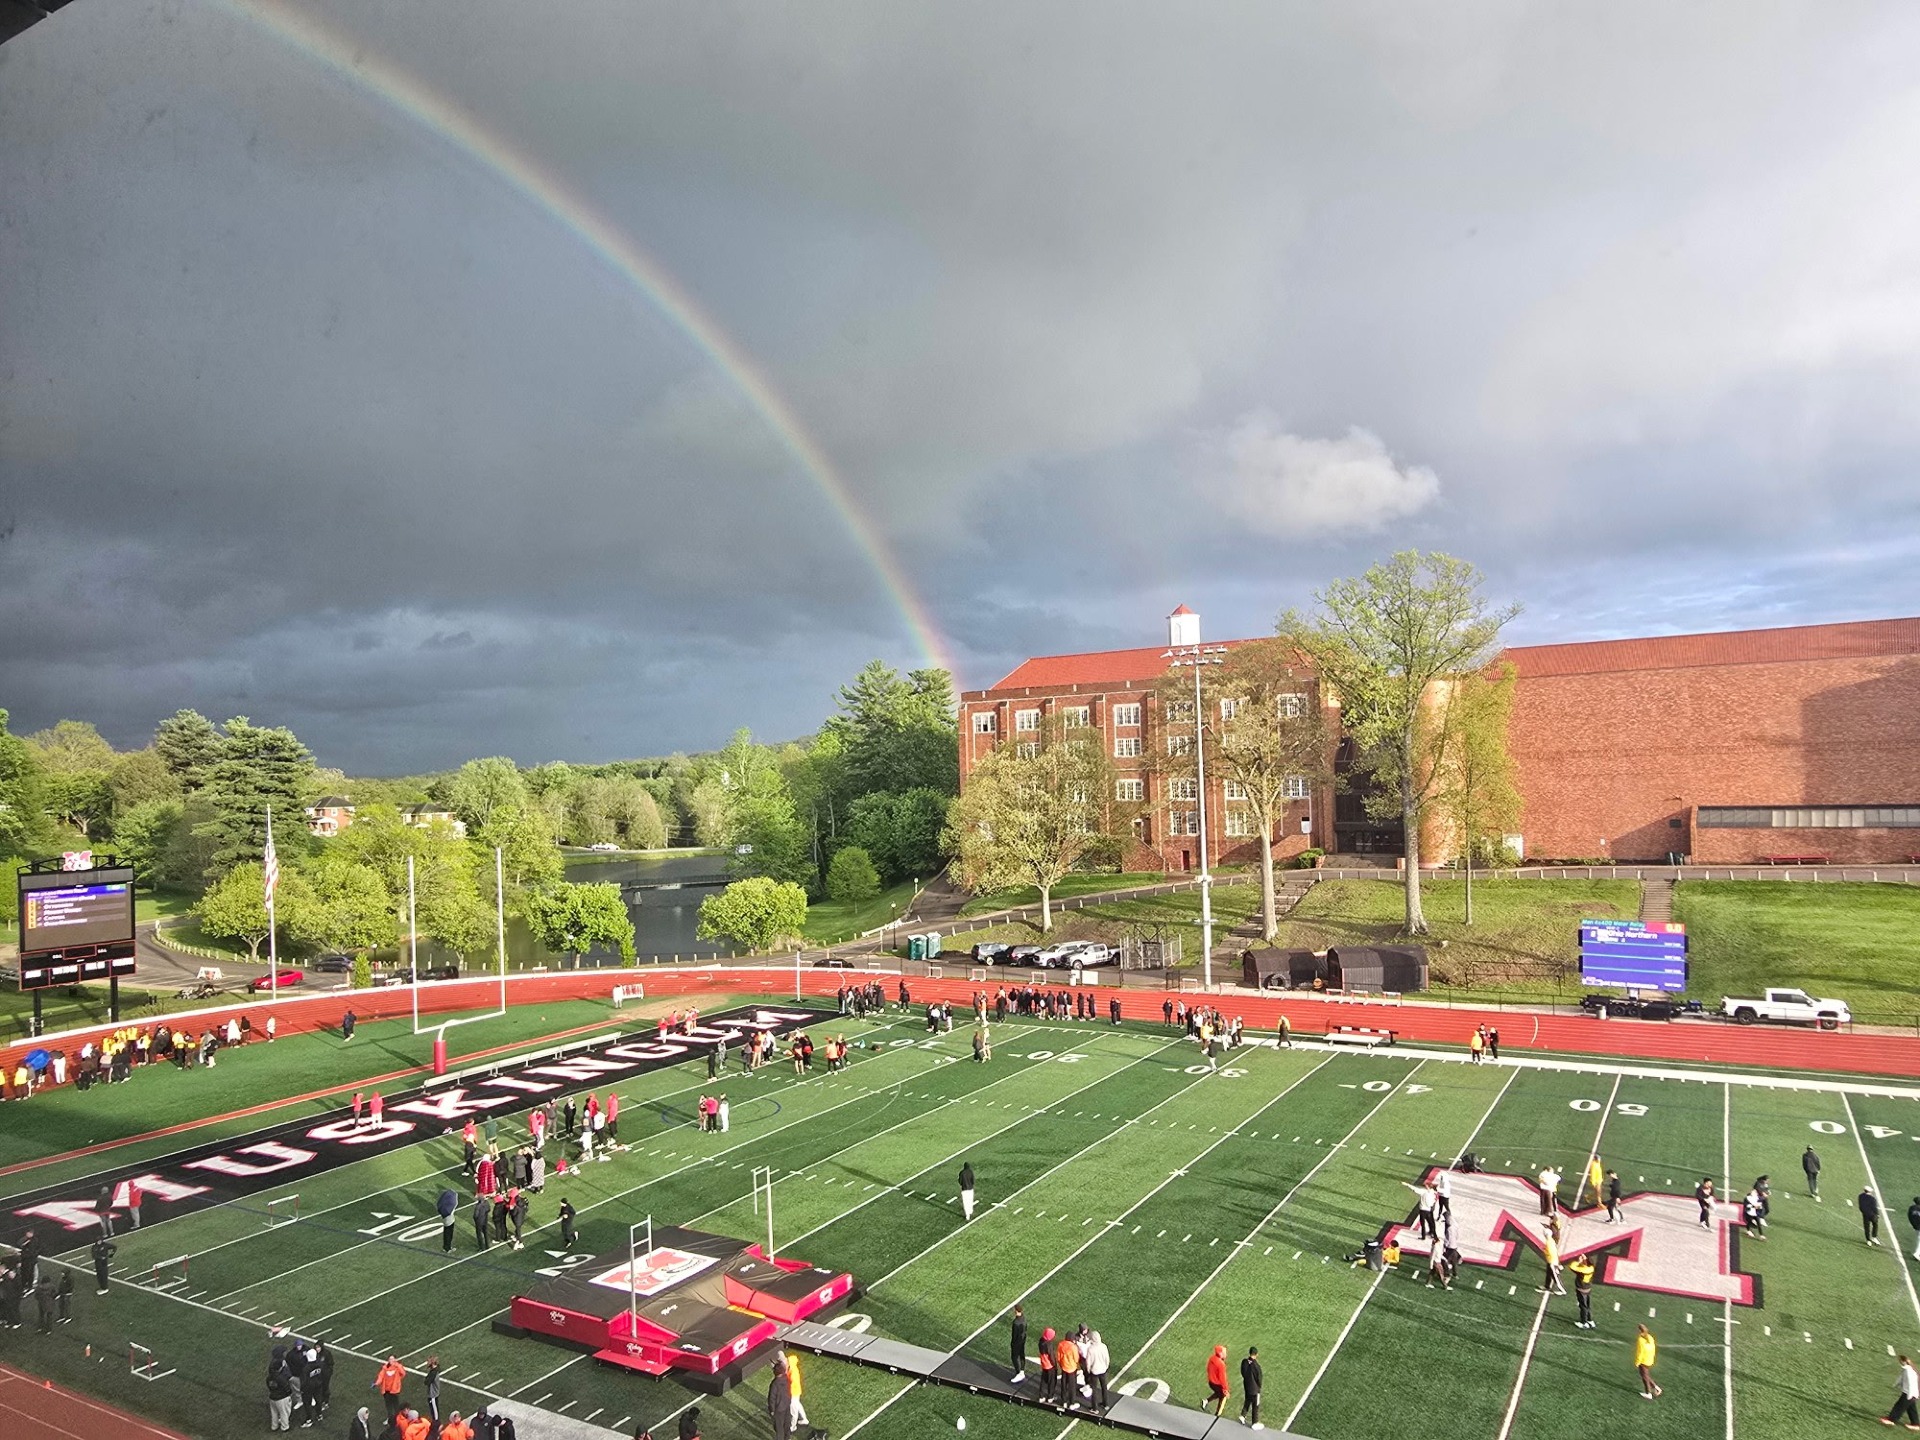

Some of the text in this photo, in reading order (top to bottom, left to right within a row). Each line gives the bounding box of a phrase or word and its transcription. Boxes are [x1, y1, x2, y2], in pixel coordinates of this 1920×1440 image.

[1625, 931, 1658, 939] Northern
[1666, 923, 1682, 933] 0.0
[1027, 1050, 1088, 1063] 20
[1184, 1065, 1248, 1078] 30
[1362, 1080, 1433, 1094] 40
[1569, 1099, 1650, 1116] 50
[13, 1010, 814, 1231] MUSKINGUM
[1809, 1120, 1902, 1138] 40
[357, 1214, 444, 1242] 10
